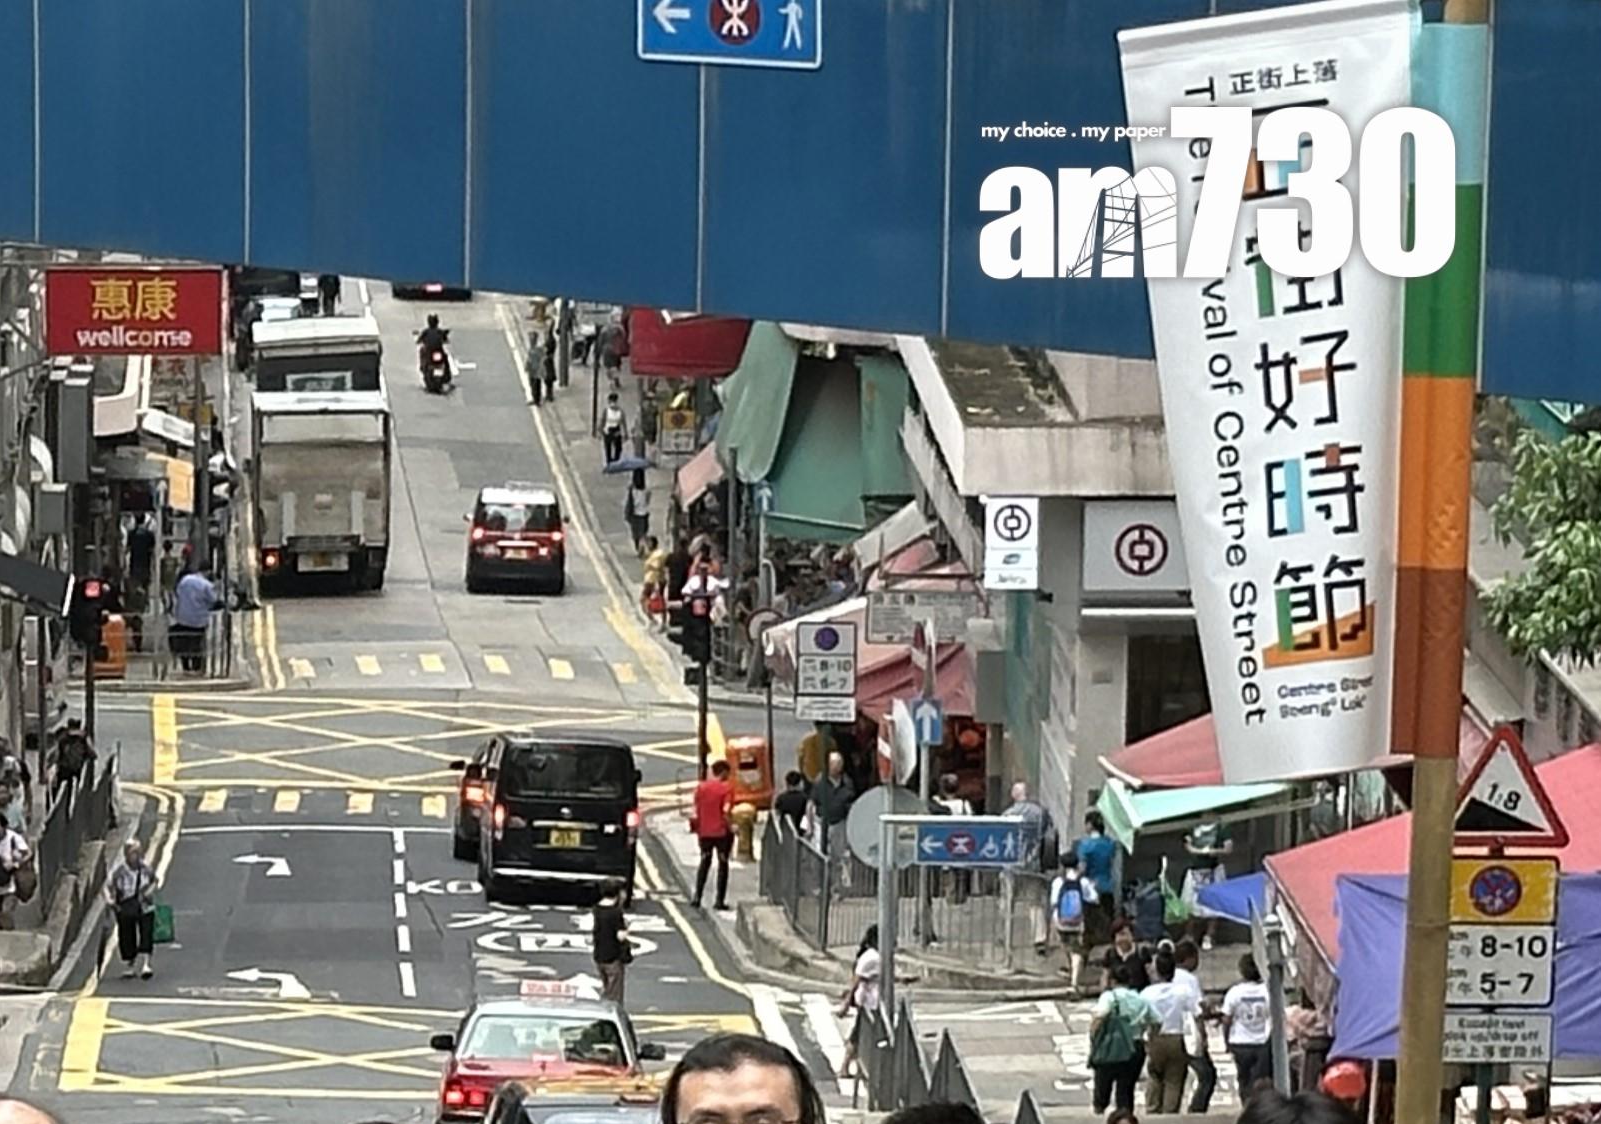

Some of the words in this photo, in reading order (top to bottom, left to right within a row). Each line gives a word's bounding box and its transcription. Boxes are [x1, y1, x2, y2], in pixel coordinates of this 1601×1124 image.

[1229, 59, 1338, 96] 正街上落
[90, 277, 177, 320] 惠康
[76, 325, 192, 347] wellcome
[1207, 353, 1243, 394] of
[1213, 411, 1248, 567] Centre
[1230, 581, 1266, 725] Street
[1480, 935, 1547, 958] 8-10
